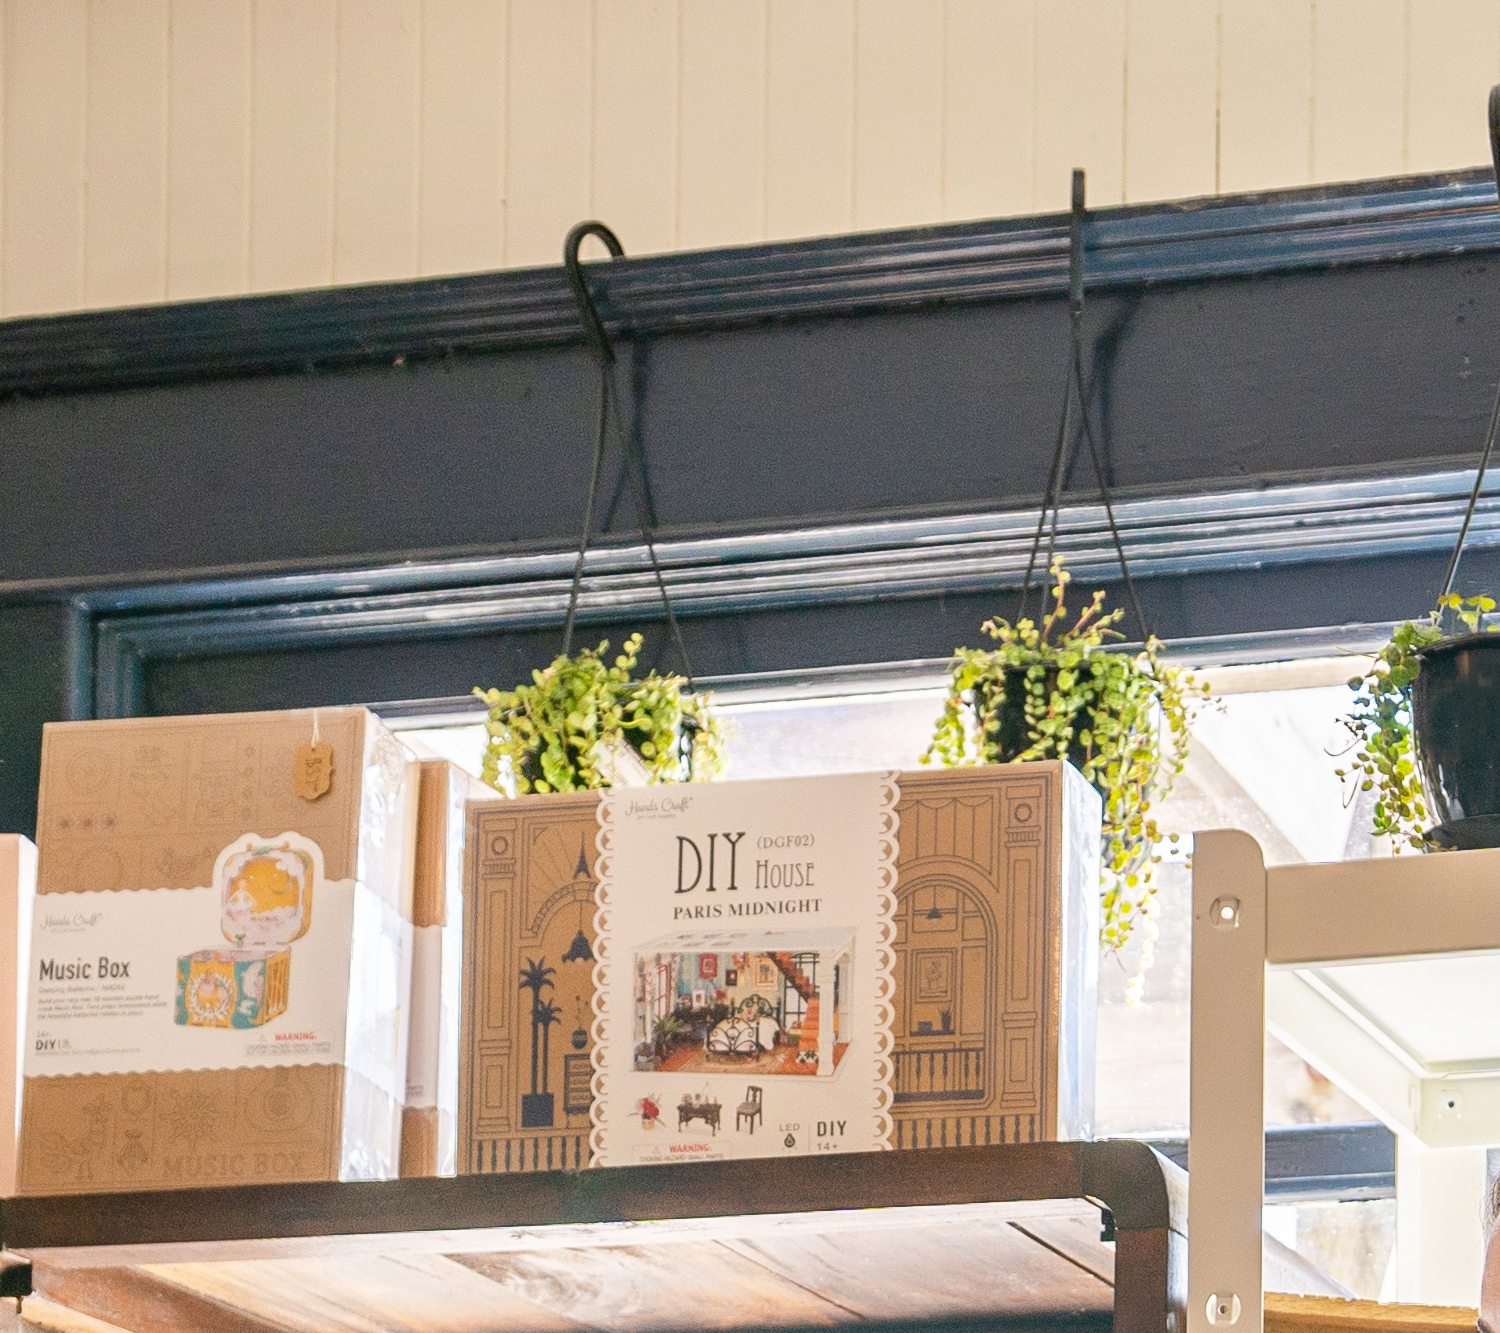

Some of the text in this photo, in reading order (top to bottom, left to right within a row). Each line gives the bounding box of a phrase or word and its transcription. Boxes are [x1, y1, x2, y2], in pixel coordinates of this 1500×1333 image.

[674, 831, 816, 893] DIY (DGF02)
[673, 898, 823, 920] PARIS MIDNIGHT
[39, 956, 131, 981] Music Box
[35, 1039, 56, 1051] DIY
[779, 1120, 847, 1137] LED DIY
